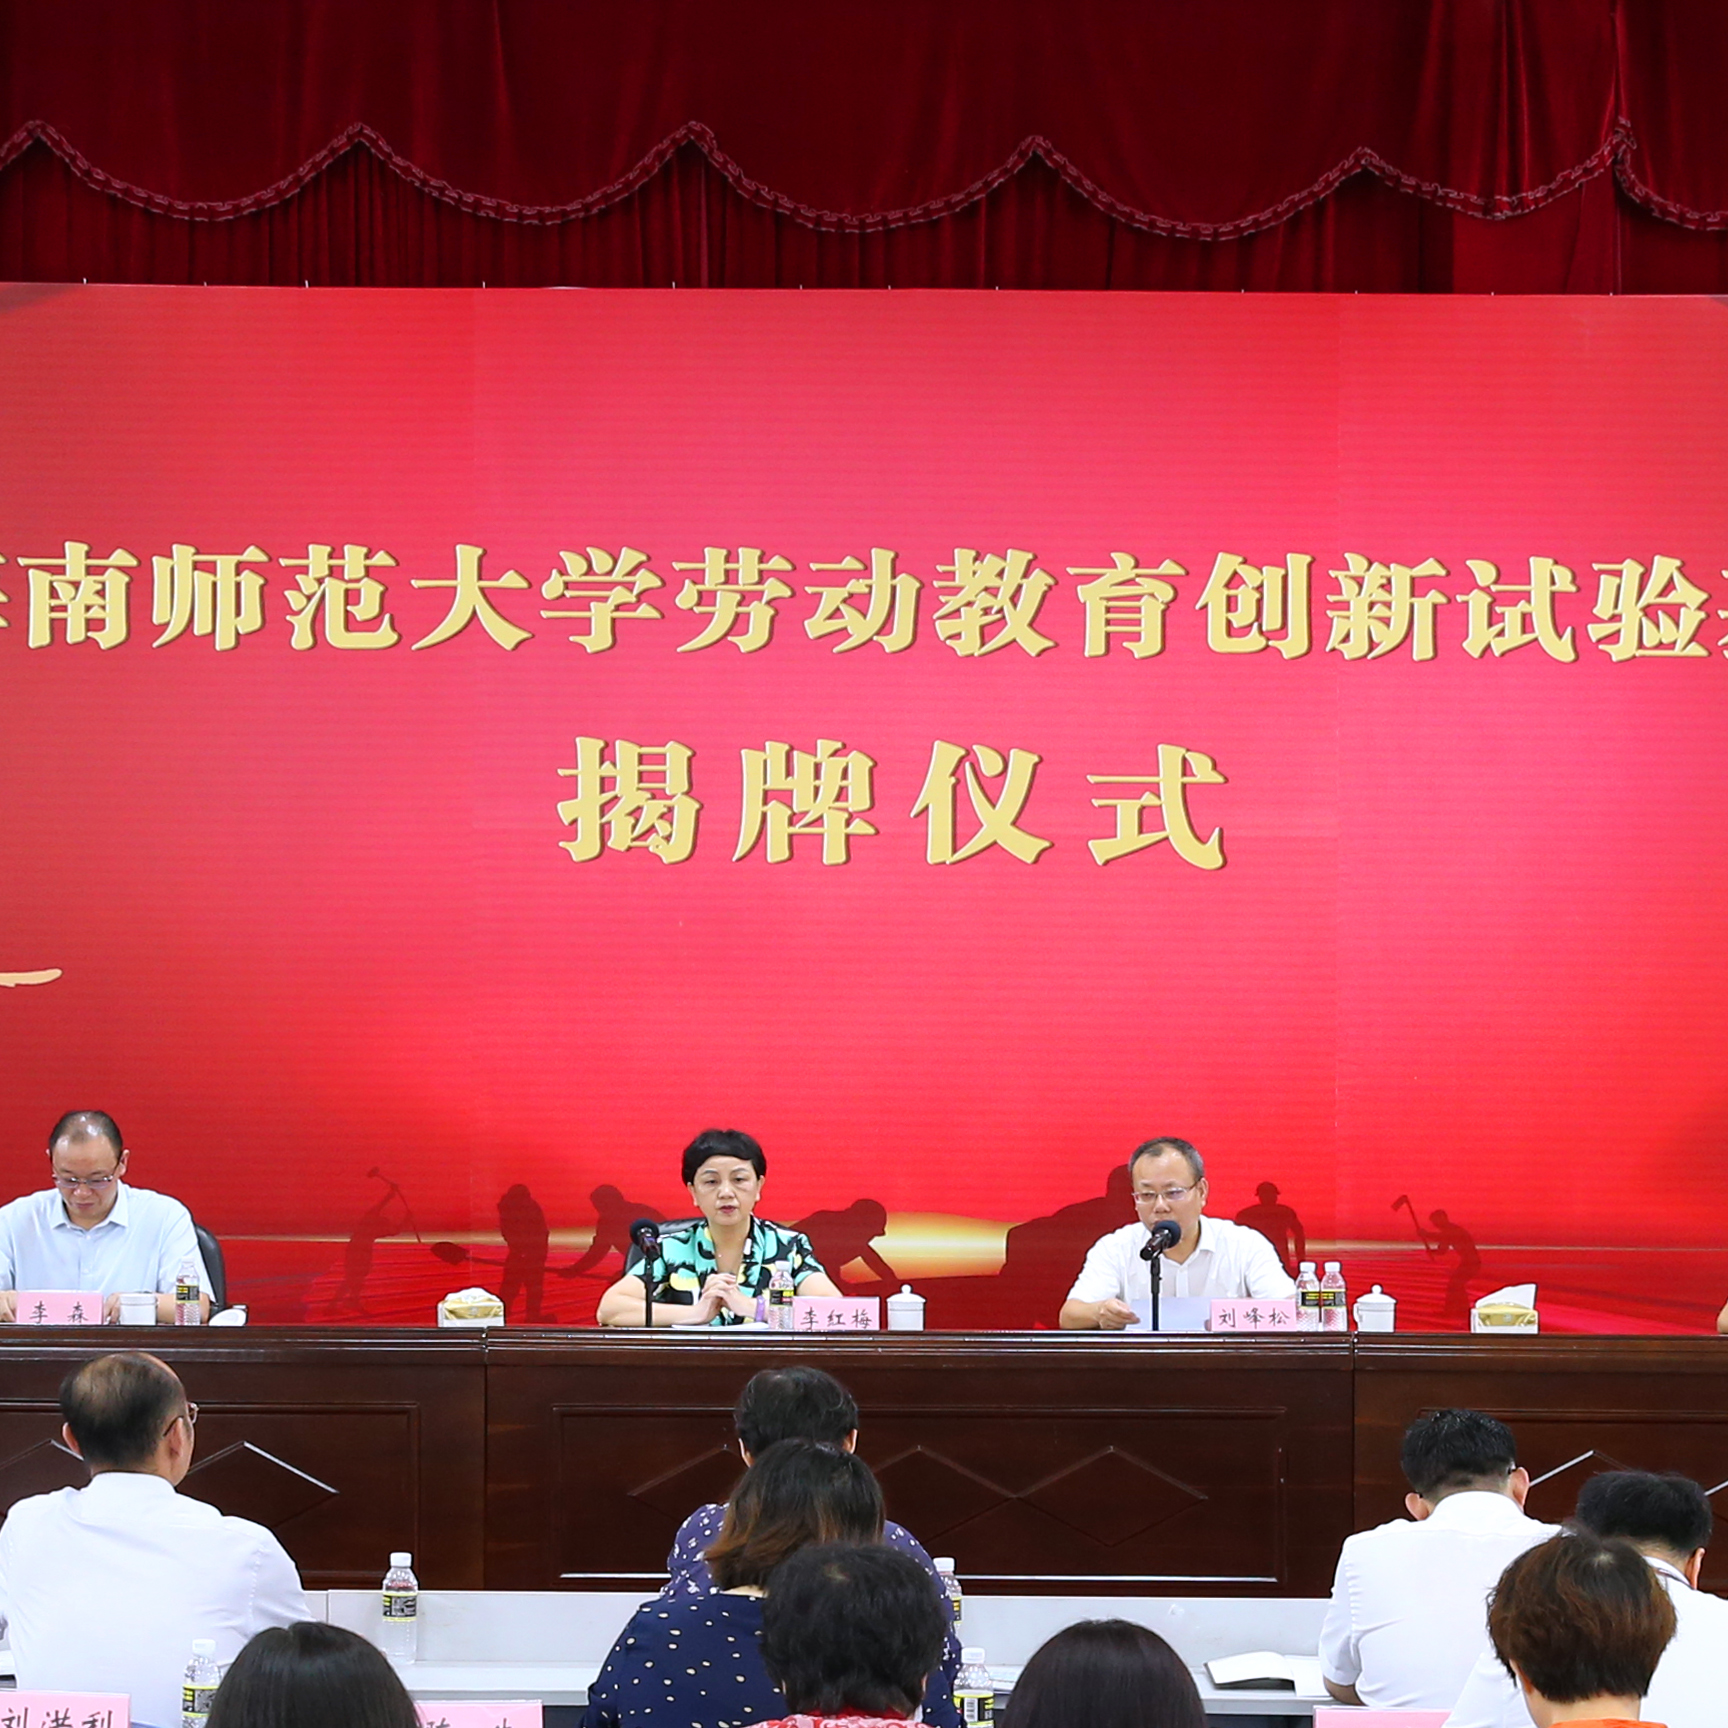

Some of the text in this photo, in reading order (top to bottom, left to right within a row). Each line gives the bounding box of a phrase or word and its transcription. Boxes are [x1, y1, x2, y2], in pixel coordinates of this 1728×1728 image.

[556, 735, 1228, 872] 揭牌仪式
[799, 1306, 873, 1330] 李红梅
[1218, 1307, 1290, 1329] 刘峰松
